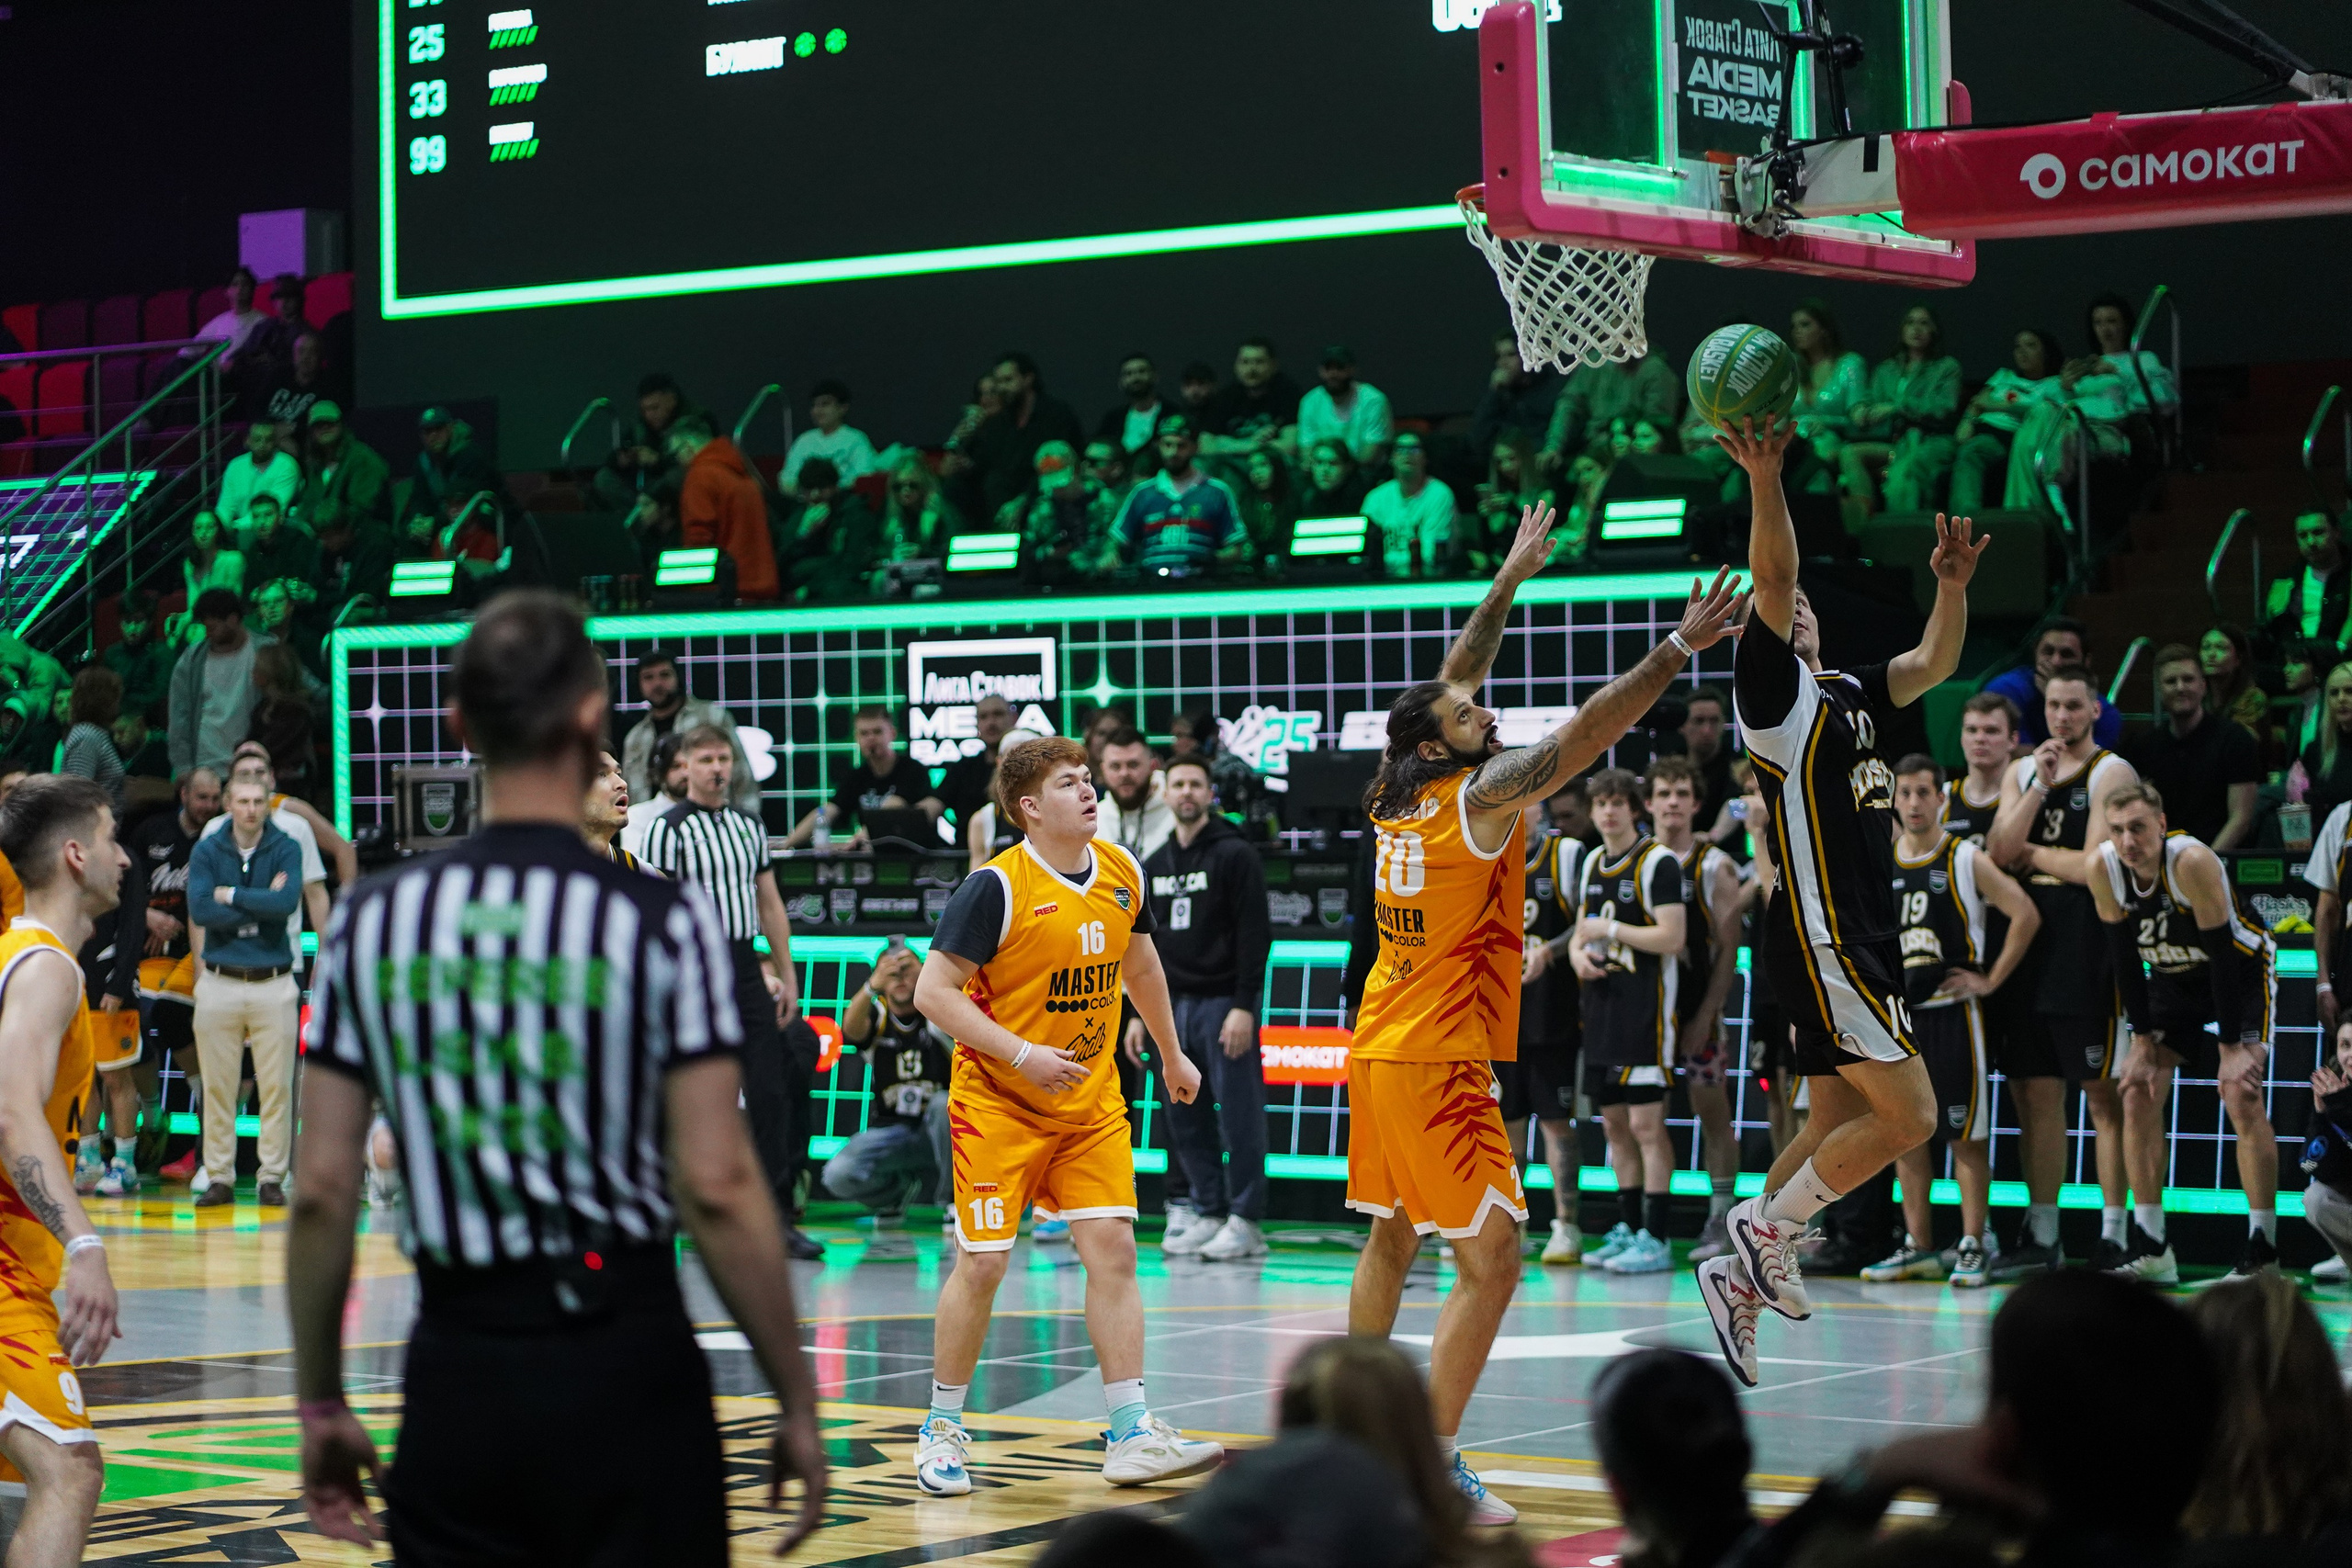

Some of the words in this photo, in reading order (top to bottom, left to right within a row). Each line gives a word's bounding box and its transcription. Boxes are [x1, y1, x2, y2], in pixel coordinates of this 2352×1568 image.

[408, 23, 446, 64] 25
[409, 78, 447, 119] 33
[409, 134, 447, 175] 99
[909, 703, 1057, 740] MEA
[1034, 905, 1058, 918] RED
[1900, 890, 1928, 927] 19
[1077, 920, 1105, 956] 16
[1393, 934, 1426, 947] COLOR
[1047, 960, 1120, 998] MASTER
[1090, 991, 1117, 1010] COLOR
[968, 1197, 1005, 1231] 16
[58, 1371, 85, 1416] 9
